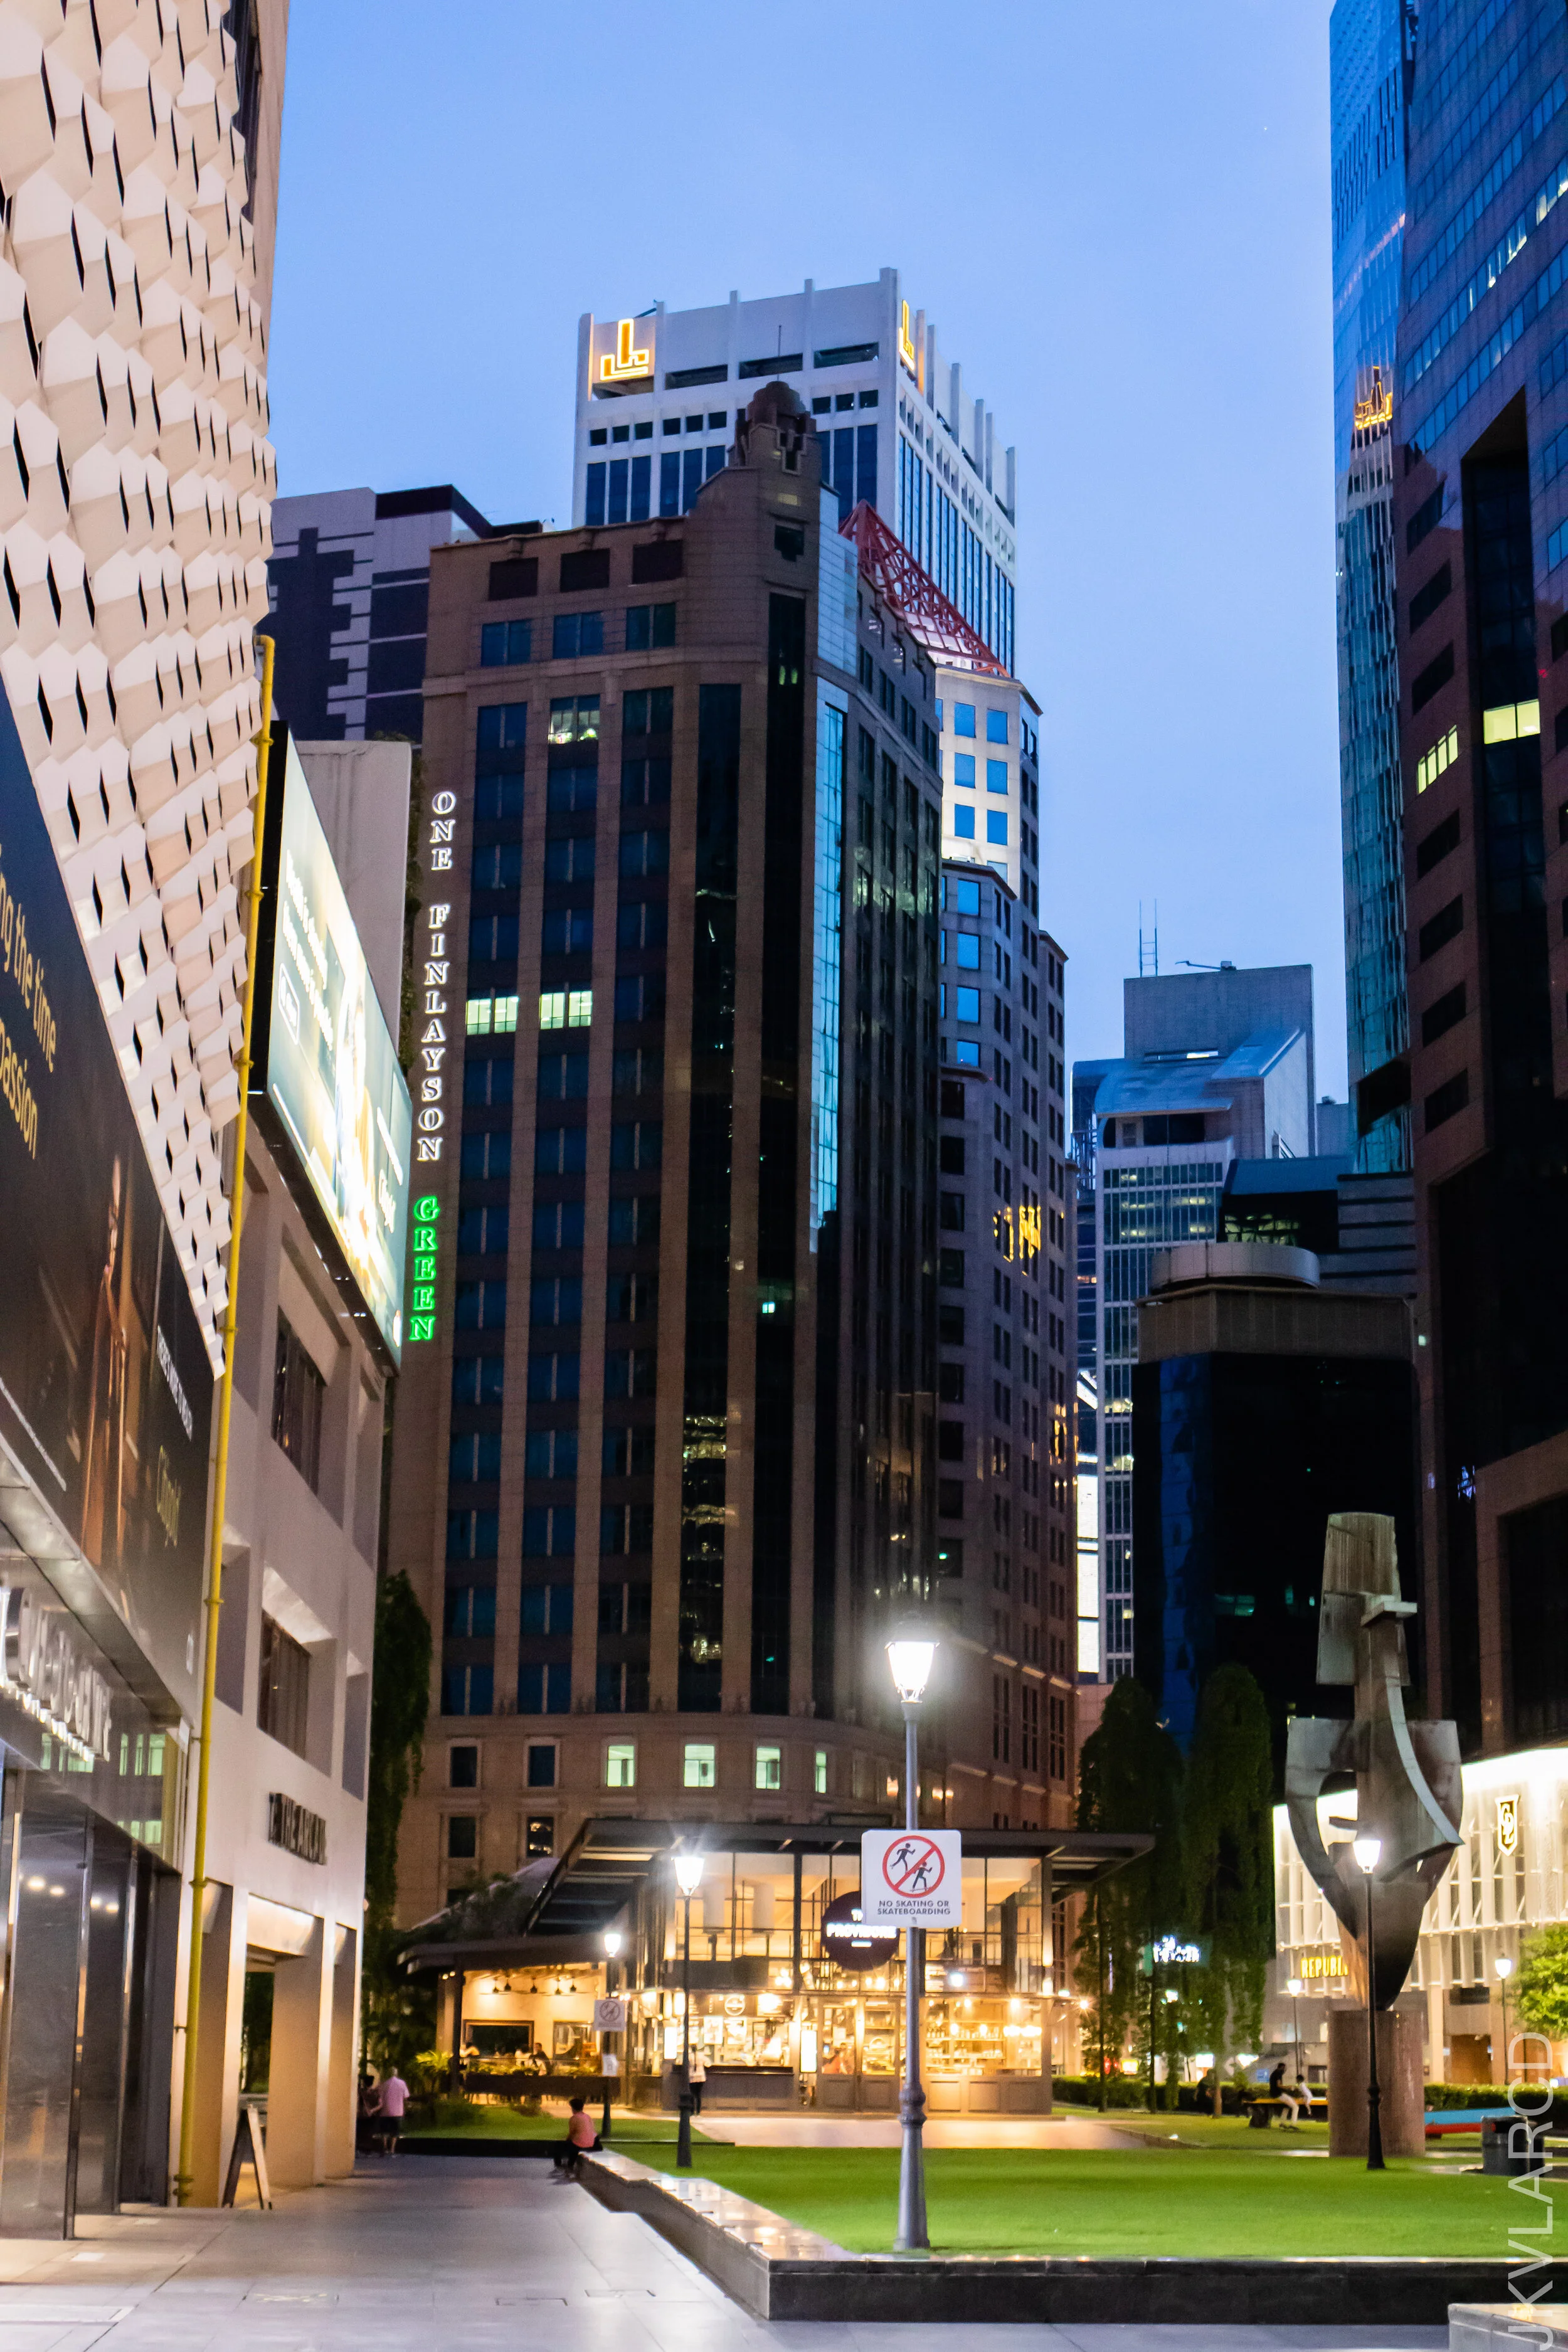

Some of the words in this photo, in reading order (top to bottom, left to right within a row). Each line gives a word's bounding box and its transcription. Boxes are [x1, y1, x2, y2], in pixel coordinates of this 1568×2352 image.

[431, 791, 456, 871] ONE
[0, 842, 13, 973] ng
[14, 903, 32, 1009] the
[34, 958, 56, 1073] time
[417, 904, 450, 1162] FINLAYSON
[409, 1195, 440, 1341] GREEN
